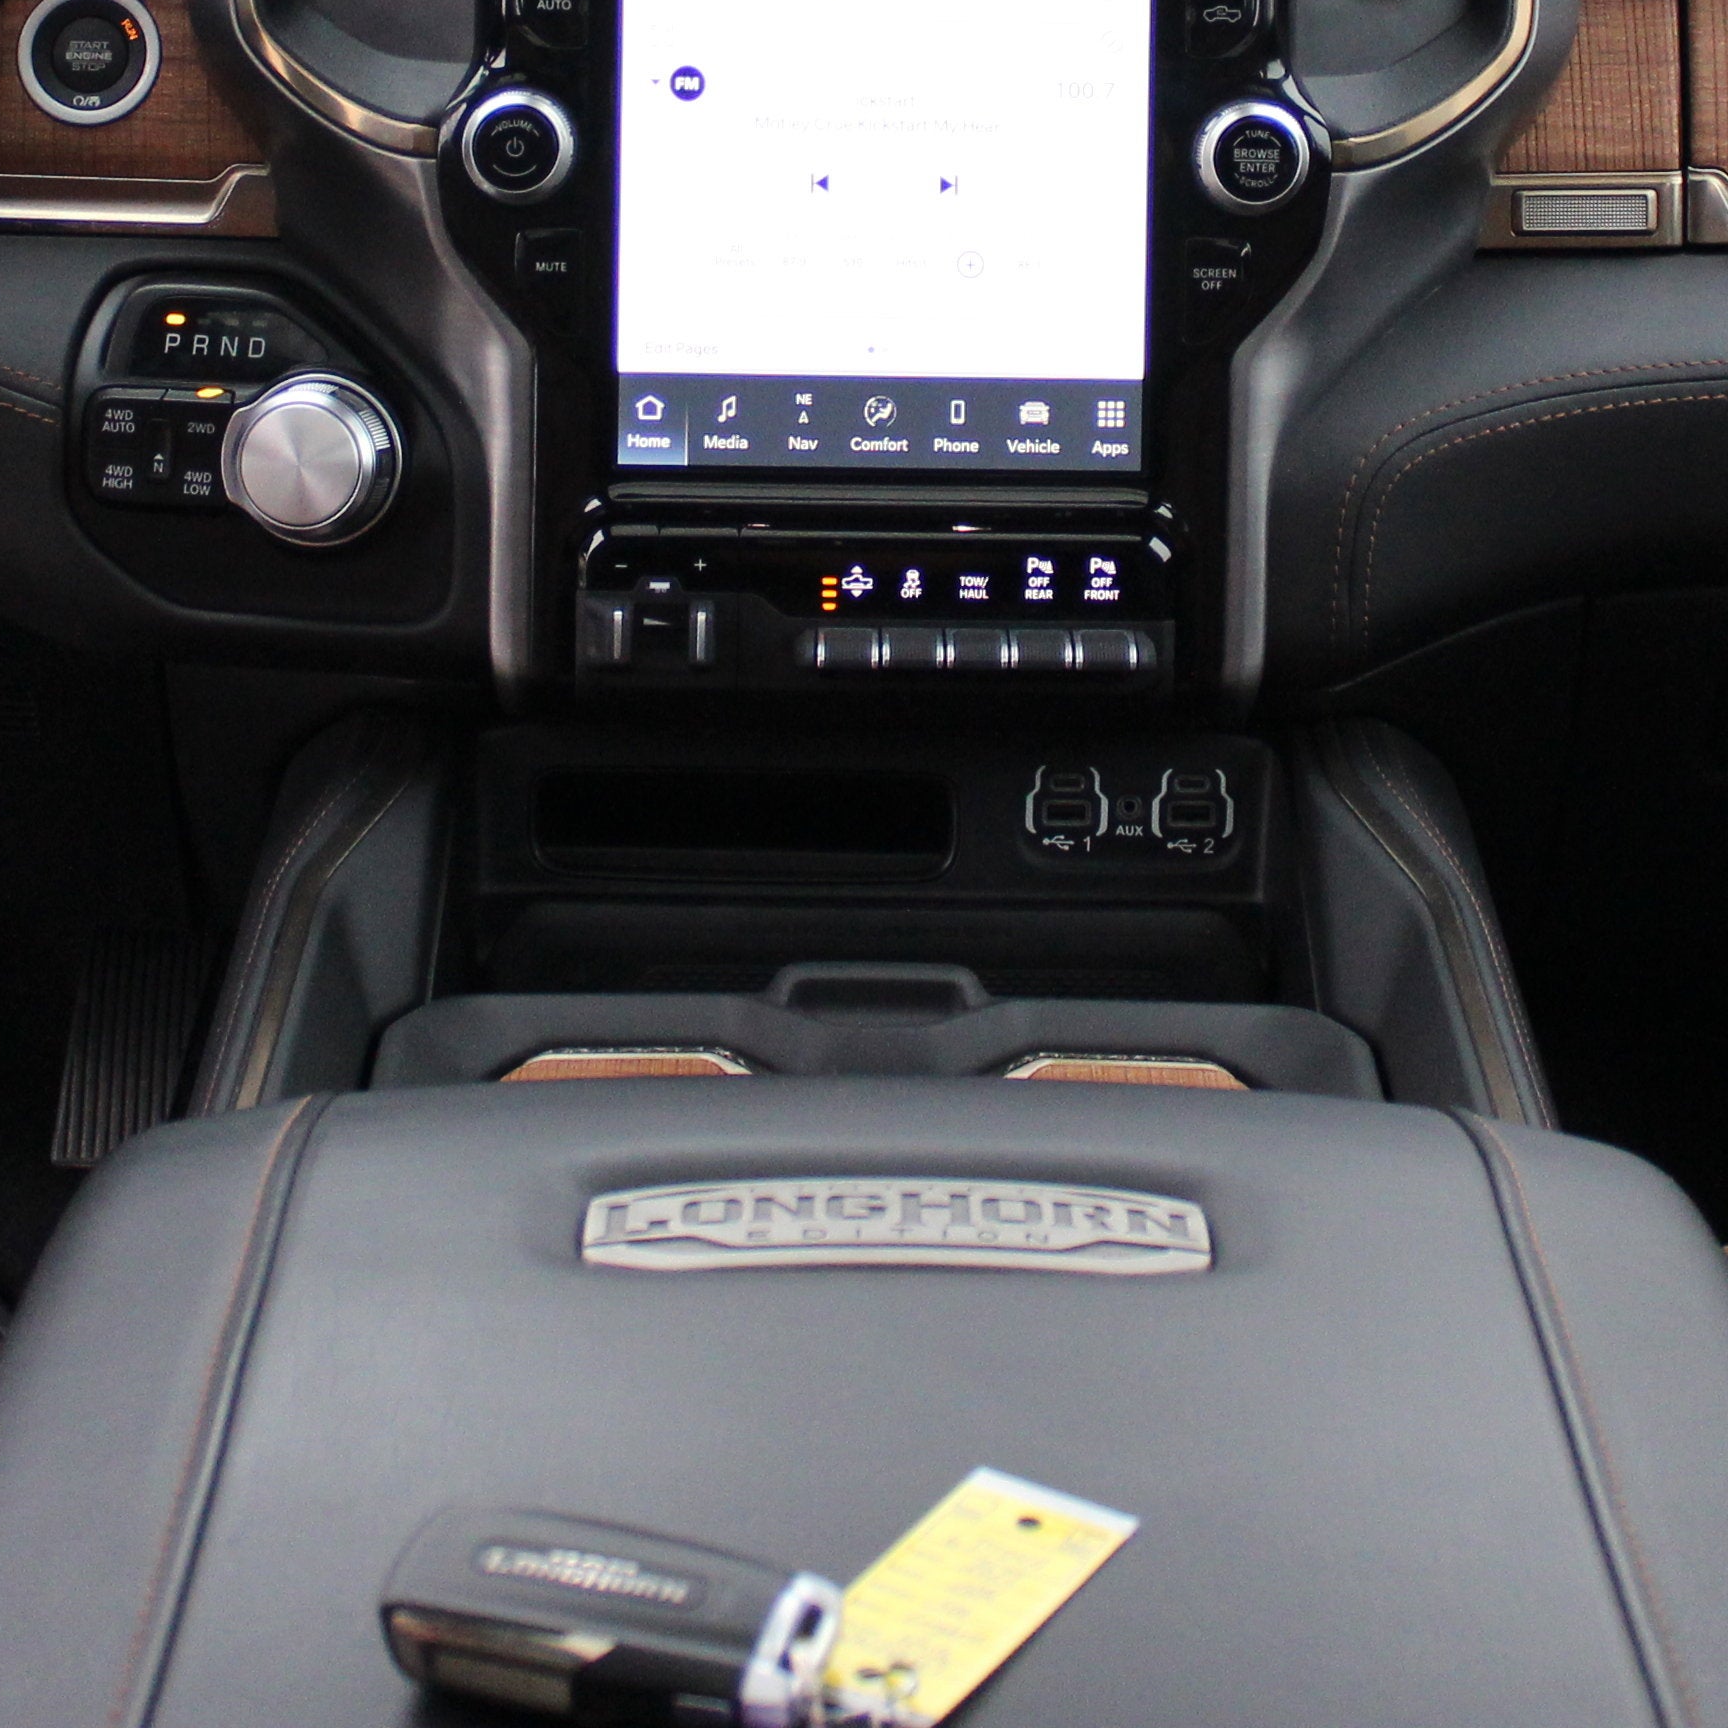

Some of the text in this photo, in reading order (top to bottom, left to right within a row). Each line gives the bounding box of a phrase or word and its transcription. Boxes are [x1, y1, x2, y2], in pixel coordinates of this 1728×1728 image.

[536, 0, 572, 11] AUTO
[120, 18, 138, 41] RUN
[68, 40, 109, 50] START
[65, 51, 113, 61] ENGINE
[71, 62, 106, 72] STOP
[675, 76, 700, 91] FM
[495, 118, 535, 132] VOLUME
[1245, 129, 1271, 139] TUNE
[1233, 148, 1281, 160] BROWSE
[1239, 162, 1276, 174] ENTER
[1239, 176, 1274, 188] SCROLL
[535, 261, 567, 272] MUTE
[1193, 268, 1237, 279] SCREEN
[1201, 280, 1223, 291] OFF
[164, 333, 266, 359] P R N D
[795, 393, 813, 406] NE
[104, 408, 134, 421] 4WD
[101, 421, 135, 434] AUTO
[187, 422, 216, 435] 2WD
[627, 433, 671, 449] Home
[703, 434, 749, 450] Media
[788, 436, 818, 451] Nav
[850, 436, 909, 452] Comfort
[933, 437, 980, 453] Phone
[1006, 438, 1061, 454] Vehicle
[1091, 440, 1130, 458] Apps
[104, 465, 133, 477] 4WD
[183, 471, 212, 484] 4WD
[102, 477, 133, 489] HIGH
[183, 483, 211, 496] LOW
[959, 576, 989, 589] TOW/
[1028, 576, 1050, 588] OFF
[1091, 577, 1113, 588] OFF
[900, 588, 922, 599] OFF
[959, 589, 989, 600] HAUL
[1024, 589, 1054, 600] REAR
[1083, 589, 1120, 601] FRONT
[1115, 825, 1144, 836] AUX
[1083, 835, 1091, 852] 1
[1203, 838, 1215, 854] 2
[602, 1192, 1201, 1243] LONGHORN
[747, 1228, 1049, 1244] EDITION
